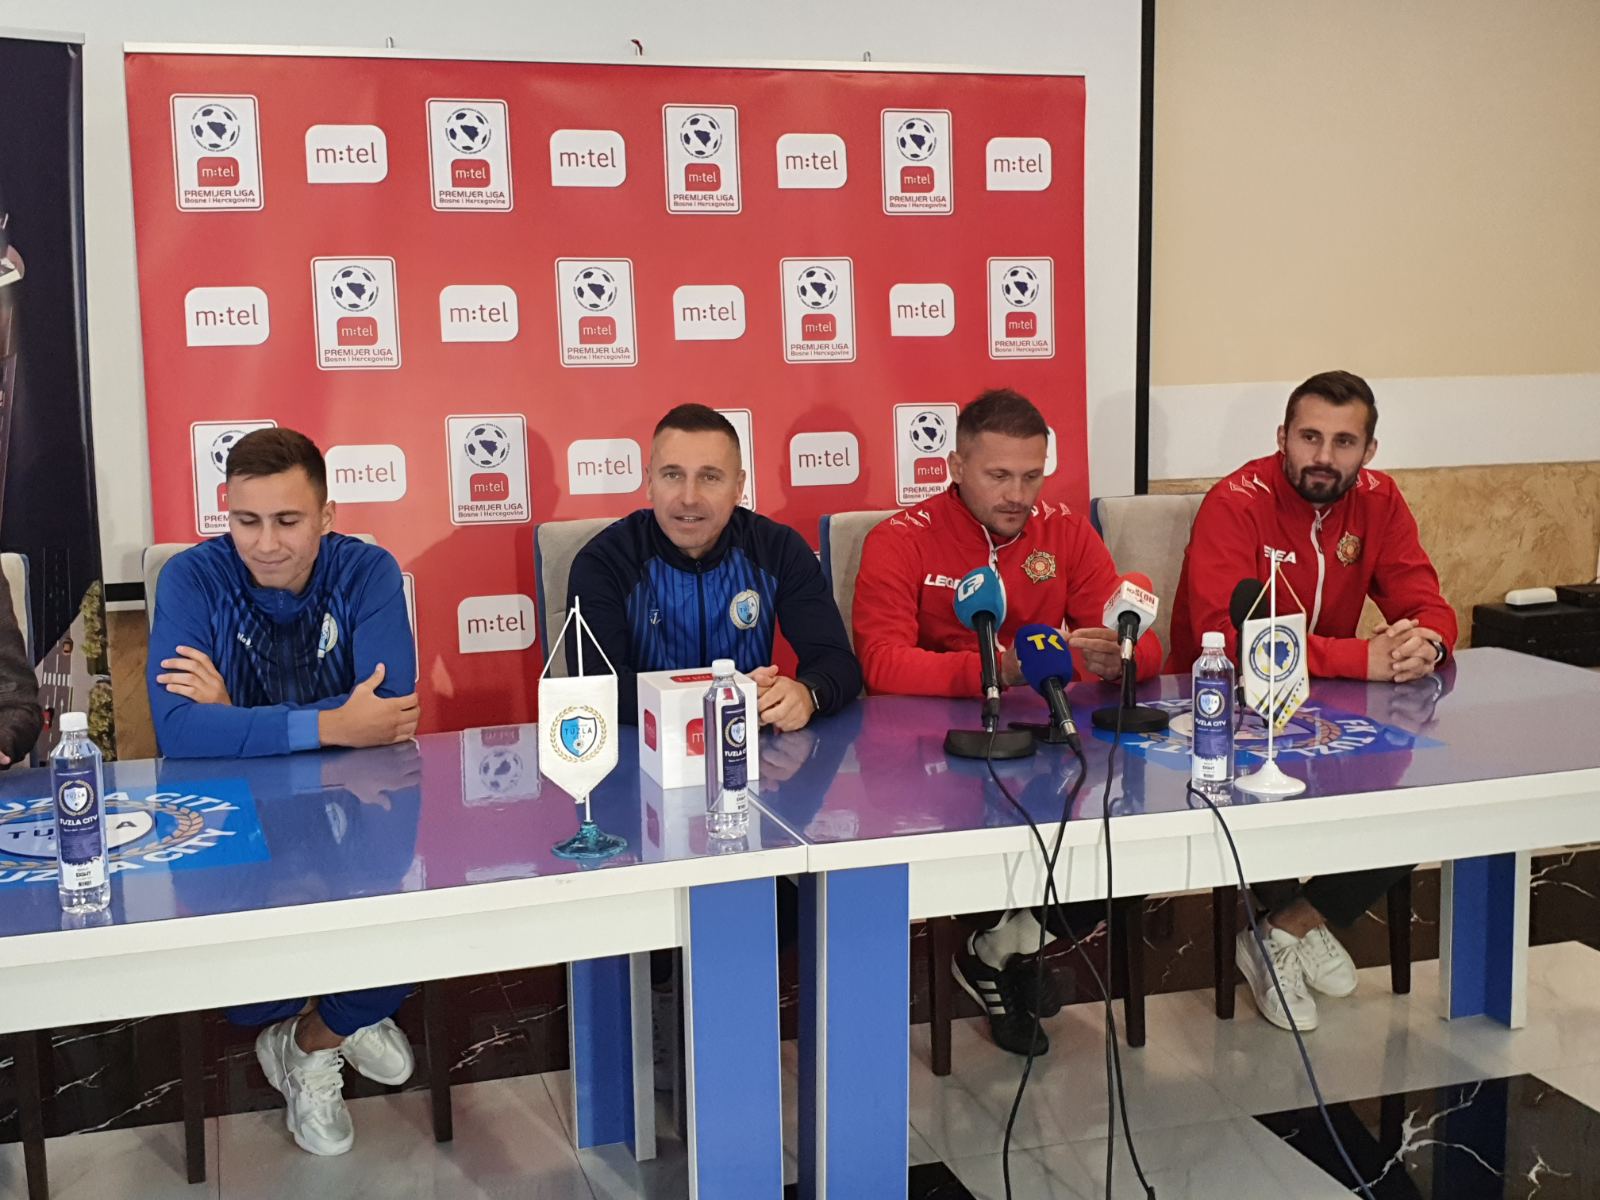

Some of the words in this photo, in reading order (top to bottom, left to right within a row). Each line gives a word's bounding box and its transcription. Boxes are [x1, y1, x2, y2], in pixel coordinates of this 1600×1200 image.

[316, 142, 377, 164] m:tel
[560, 147, 616, 168] m:tel
[786, 150, 838, 170] m:tel
[202, 166, 234, 178] m:tel
[456, 167, 486, 179] m:tel
[994, 154, 1043, 173] m:tel
[688, 171, 716, 183] m:tel
[904, 174, 931, 185] m:tel
[184, 190, 232, 198] PREMIJER
[196, 304, 259, 326] m:tel
[450, 302, 508, 323] m:tel
[682, 301, 736, 321] m:tel
[898, 299, 946, 319] m:tel
[341, 325, 374, 337] m:tel
[583, 324, 612, 336] m:tel
[805, 322, 832, 333] m:tel
[1008, 319, 1033, 330] m:tel
[577, 455, 632, 476] m:tel
[799, 447, 850, 468] m:tel
[335, 461, 396, 484] m:tel
[917, 465, 943, 476] m:tel
[474, 481, 504, 493] m:tel
[468, 610, 525, 634] m:tel
